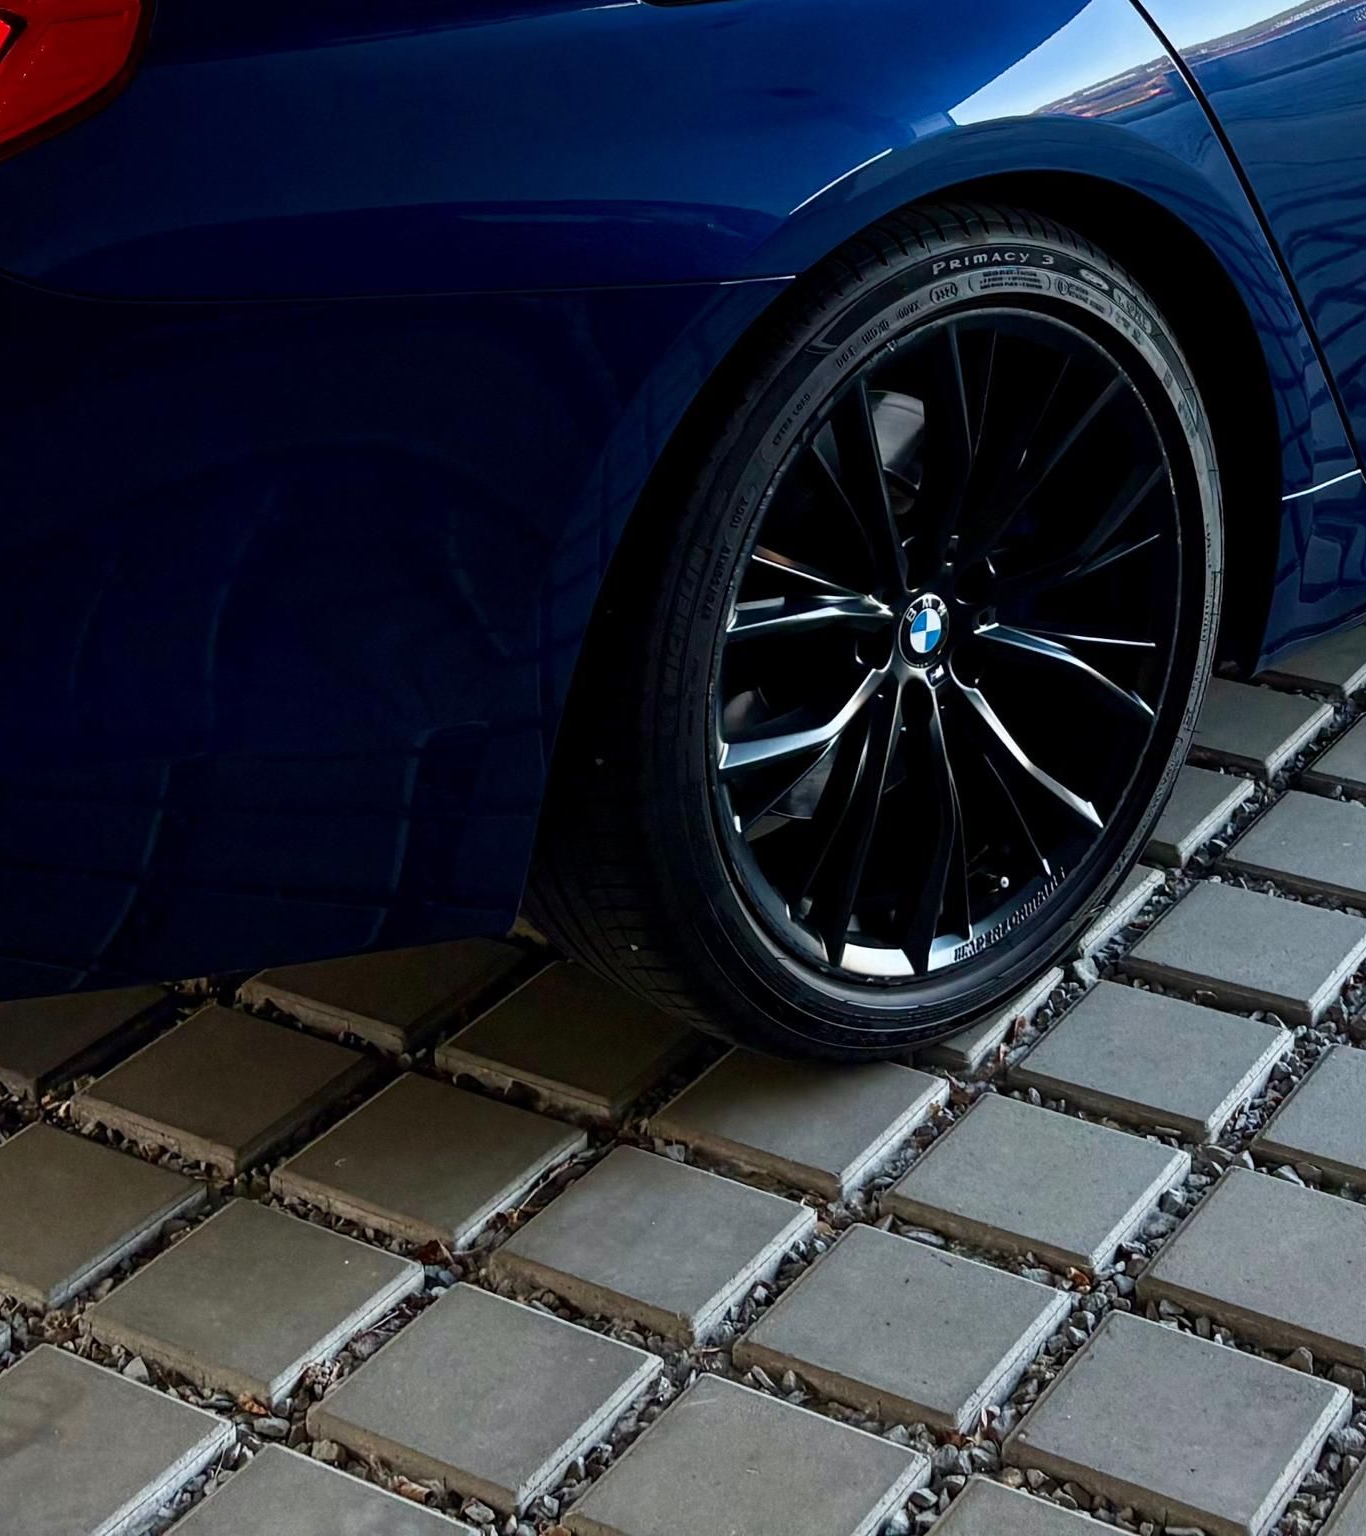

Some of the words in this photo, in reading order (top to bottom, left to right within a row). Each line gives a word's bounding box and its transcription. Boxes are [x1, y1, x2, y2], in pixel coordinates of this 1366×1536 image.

[932, 251, 1031, 276] PRIMACY
[1042, 254, 1055, 266] 3
[906, 597, 948, 623] BMW
